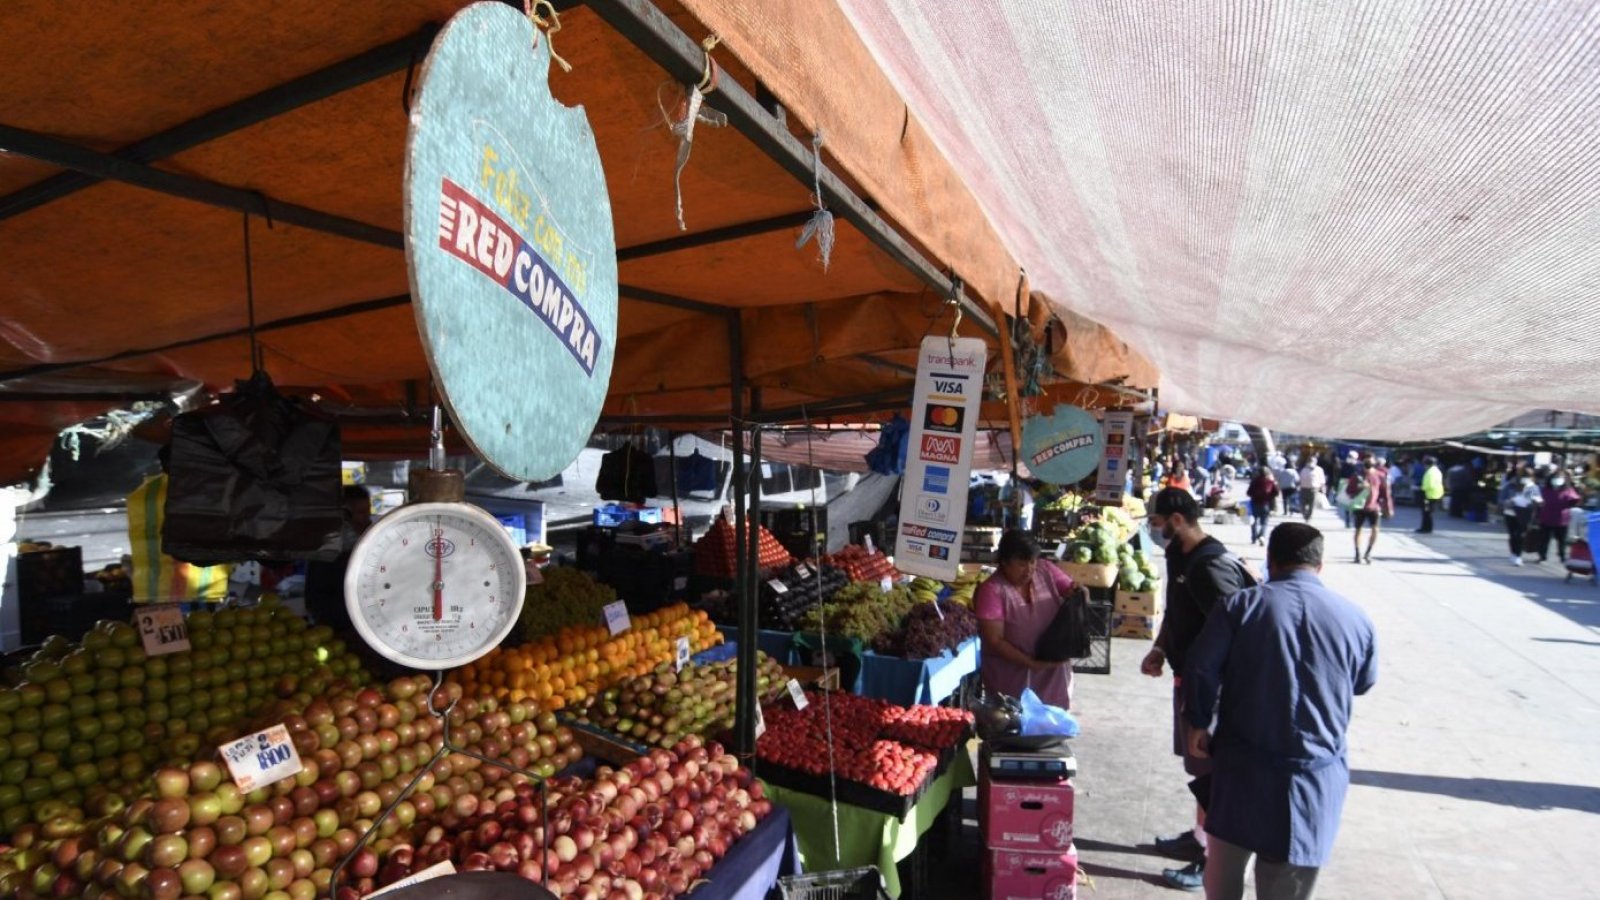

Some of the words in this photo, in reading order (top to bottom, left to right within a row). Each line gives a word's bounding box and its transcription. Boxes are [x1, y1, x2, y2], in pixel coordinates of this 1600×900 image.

[481, 143, 531, 232] Feliz
[935, 380, 963, 394] VISA
[921, 451, 958, 463] MAGNA
